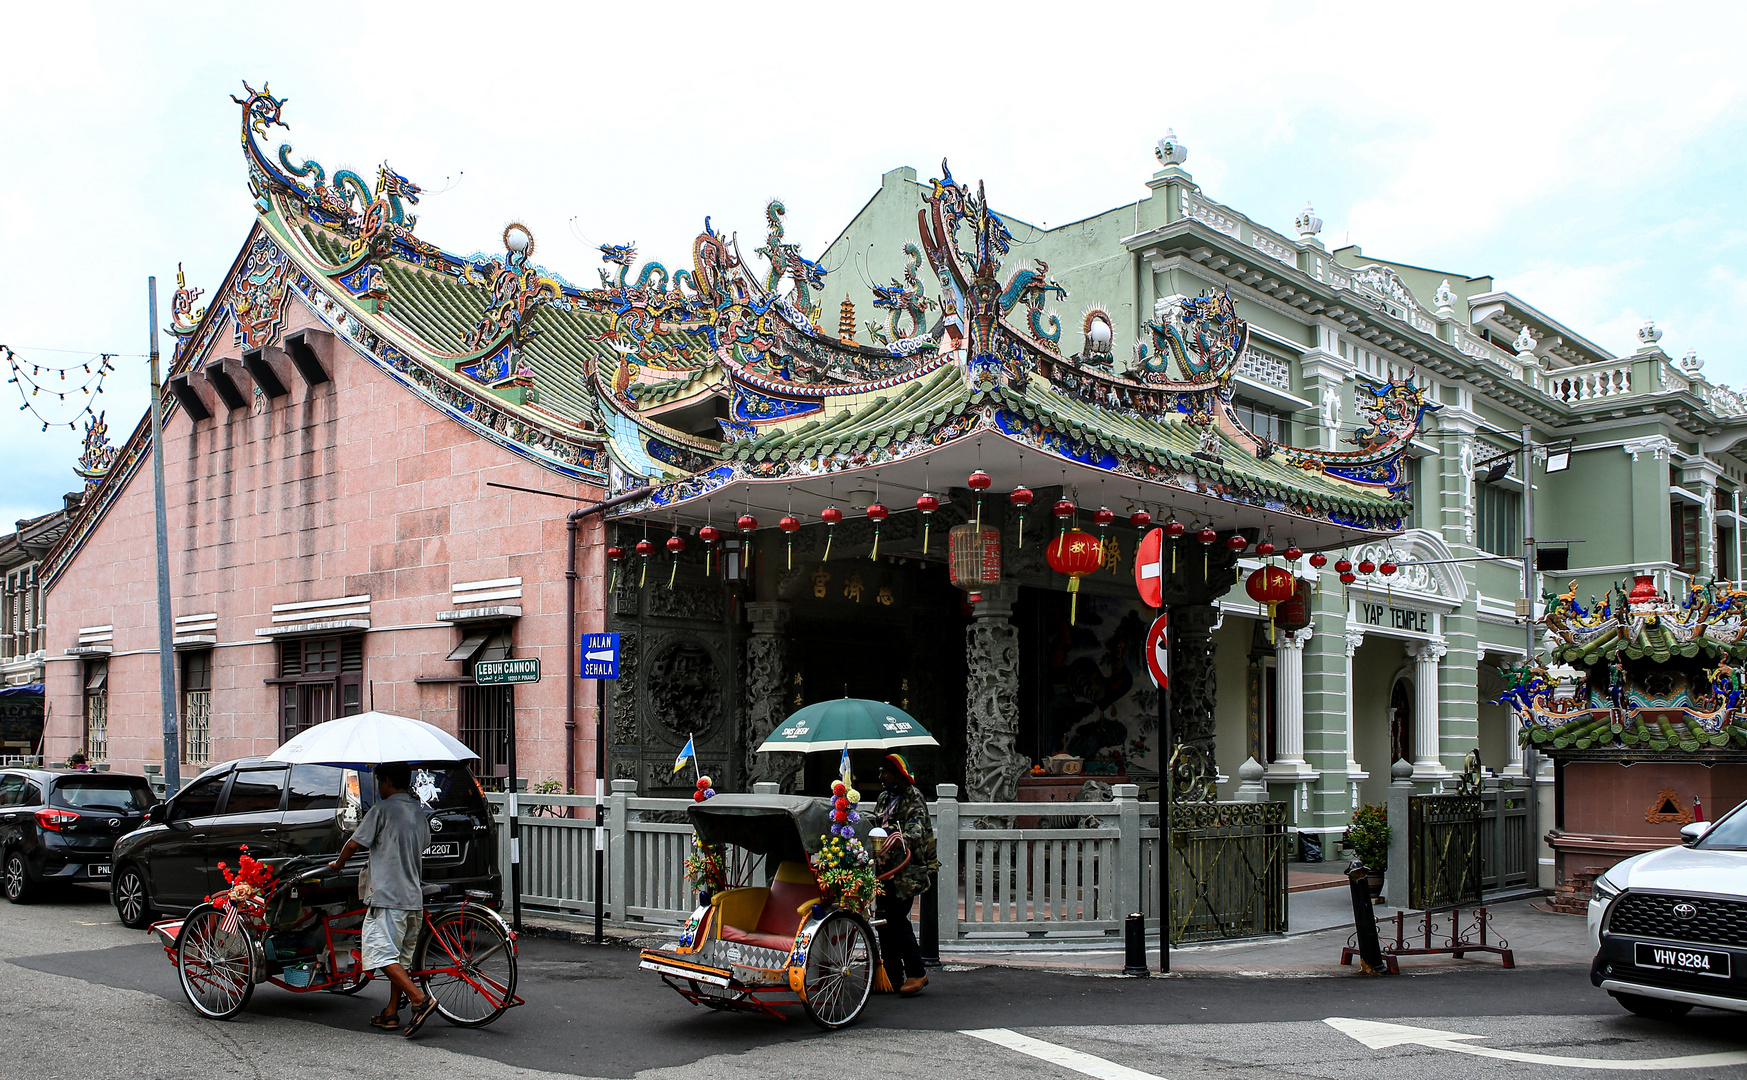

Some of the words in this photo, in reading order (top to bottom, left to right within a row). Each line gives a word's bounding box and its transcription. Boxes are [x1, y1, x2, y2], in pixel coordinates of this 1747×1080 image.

[1363, 603, 1383, 625] YAP
[1389, 607, 1427, 632] TEMPLE
[588, 636, 611, 648] JALAN
[478, 662, 503, 675] LEBUH
[503, 661, 536, 674] CANNON
[584, 664, 613, 675] SEHALA
[431, 844, 451, 855] 2207
[97, 866, 111, 874] PNL
[1653, 948, 1677, 966] VHV
[1677, 952, 1711, 970] 9284
